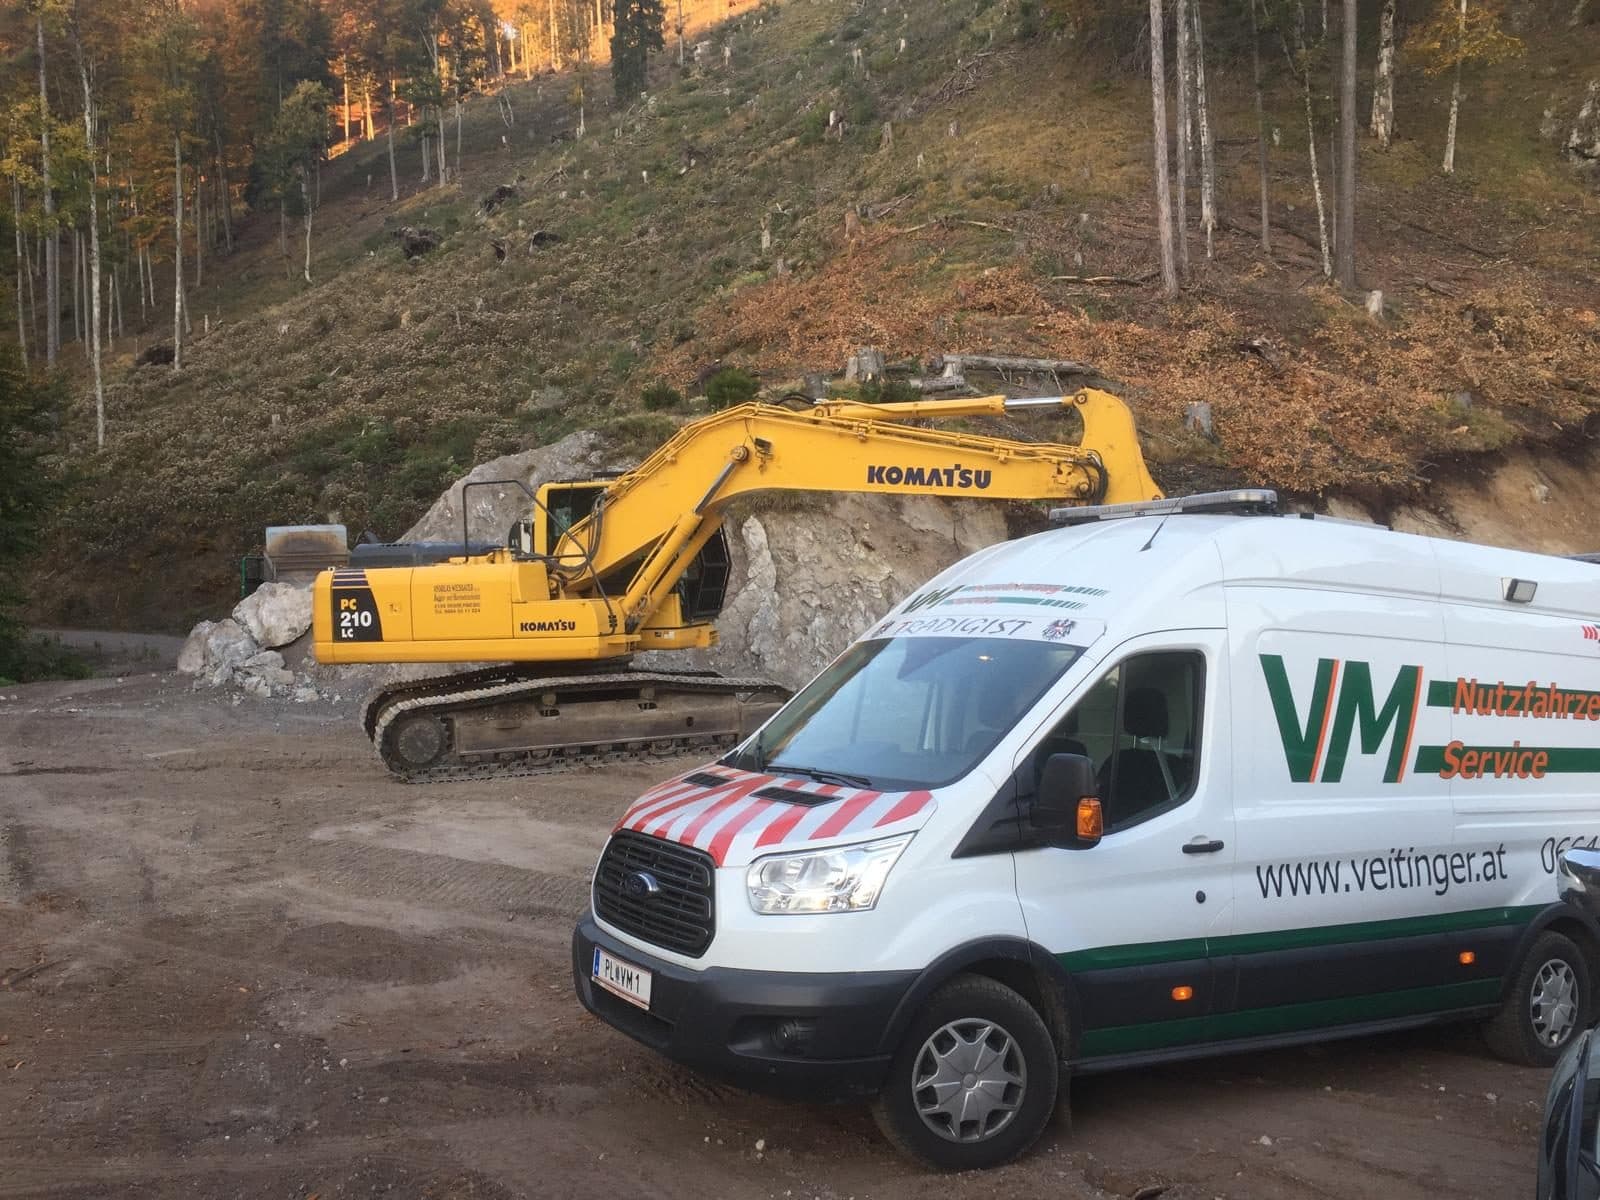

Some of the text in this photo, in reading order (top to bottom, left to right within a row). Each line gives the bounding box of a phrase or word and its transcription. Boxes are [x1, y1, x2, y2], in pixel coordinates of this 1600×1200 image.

[867, 463, 991, 489] KOMATSU
[340, 598, 357, 610] PC
[340, 610, 372, 627] 210
[520, 619, 576, 632] KOMATSU
[341, 628, 354, 638] LC
[1452, 677, 1600, 721] Nutzfahrze
[1258, 653, 1424, 784] VM
[1439, 740, 1549, 780] Service
[1256, 842, 1508, 900] www.veitinger.at
